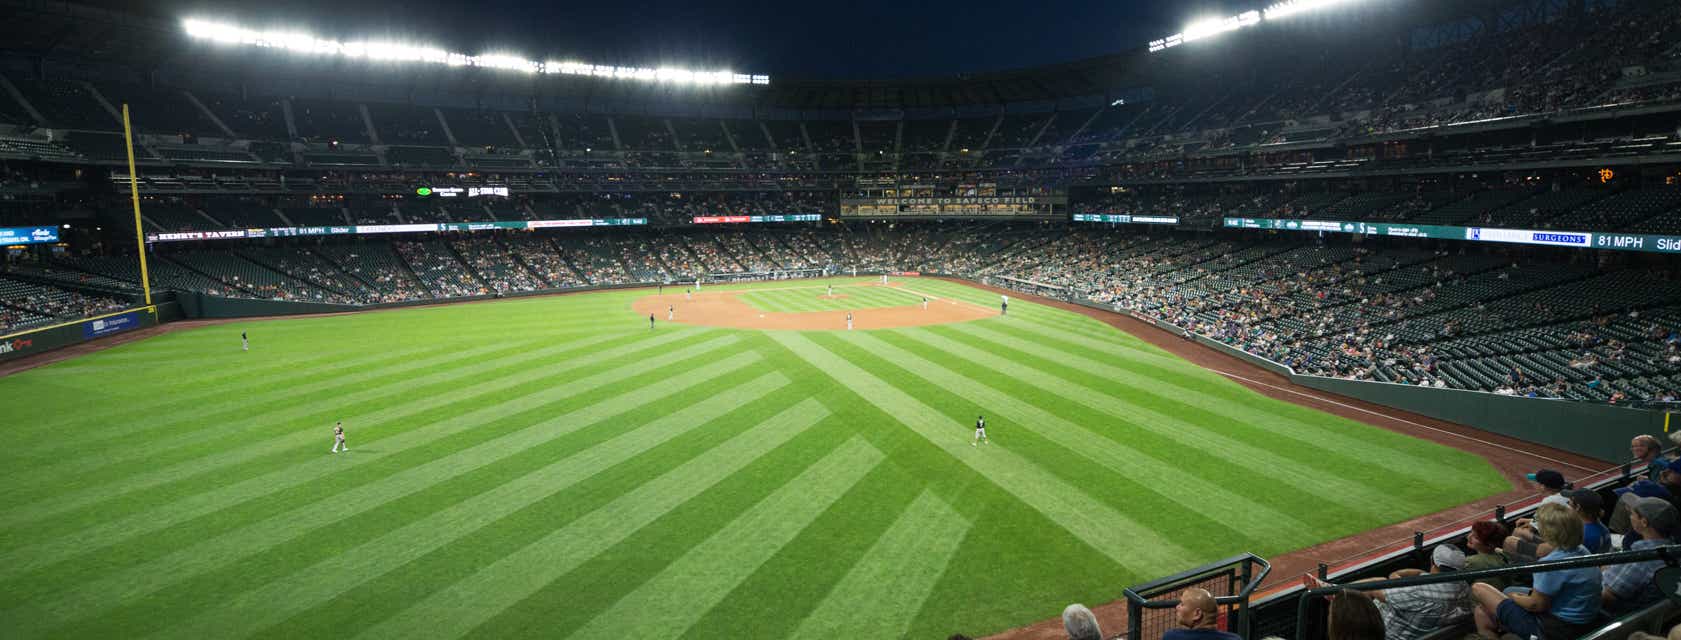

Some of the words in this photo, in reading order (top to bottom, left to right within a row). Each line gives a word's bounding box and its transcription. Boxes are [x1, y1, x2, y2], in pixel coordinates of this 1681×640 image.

[158, 232, 203, 240] HENRY'S
[205, 230, 245, 238] TAVERN
[1534, 233, 1583, 243] SURGEONS
[1598, 236, 1611, 246] 81
[1614, 236, 1643, 248] MPH
[1656, 238, 1681, 250] Slid
